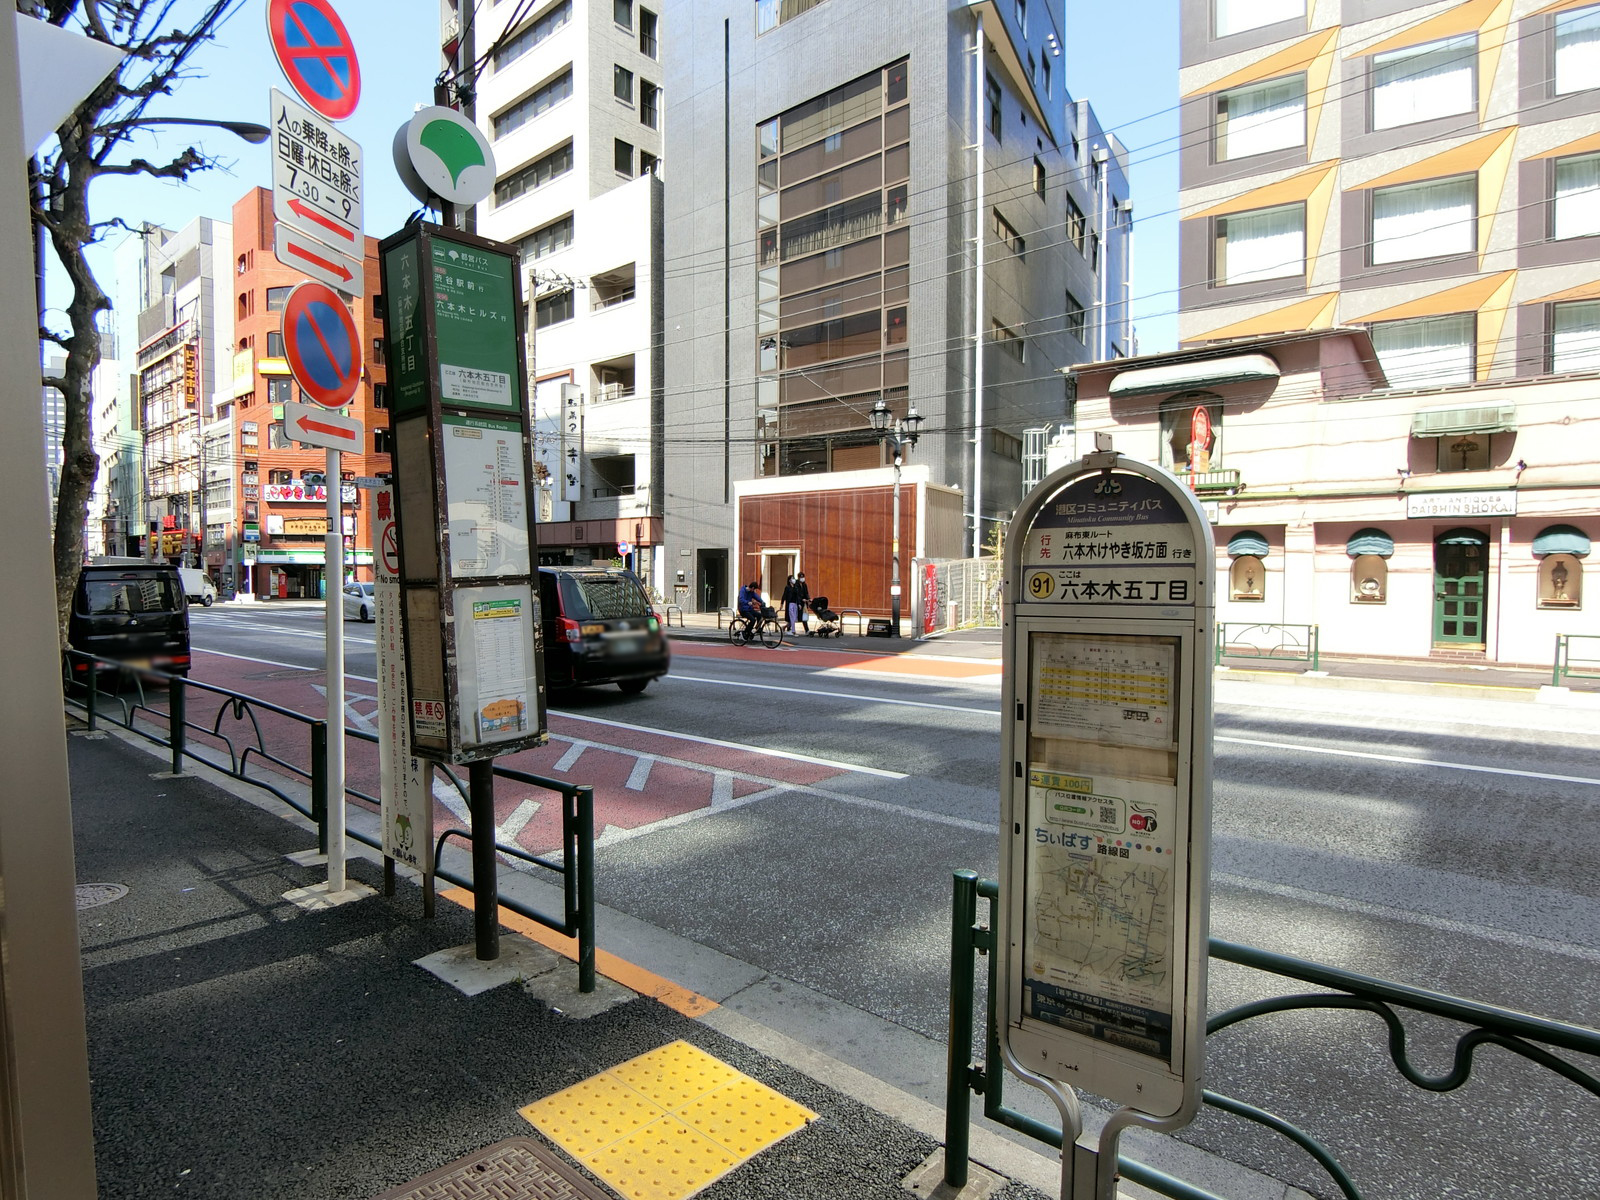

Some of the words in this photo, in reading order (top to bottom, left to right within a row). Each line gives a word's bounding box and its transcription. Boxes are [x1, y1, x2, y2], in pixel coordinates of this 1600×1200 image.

[277, 105, 359, 174] 人の乗降を除く
[278, 132, 359, 200] 日曜・休日を除く
[461, 253, 488, 266] 都営バス
[401, 254, 415, 371] 六本木五丁目
[459, 369, 506, 384] 六本木五丁目
[1056, 500, 1162, 515] 港区コミュニティバス
[1097, 515, 1134, 523] Community
[1065, 531, 1112, 540] 麻布東ルート
[1040, 535, 1051, 559] 行先
[1063, 541, 1167, 560] 六本木けやき坂方面
[1172, 549, 1192, 559] 行き
[380, 574, 388, 583] No
[1058, 571, 1081, 579] ここは
[1032, 577, 1050, 593] 91
[1061, 580, 1188, 600] 六本木五丁目
[415, 701, 433, 716] 禁煙
[1097, 844, 1129, 859] 路線図
